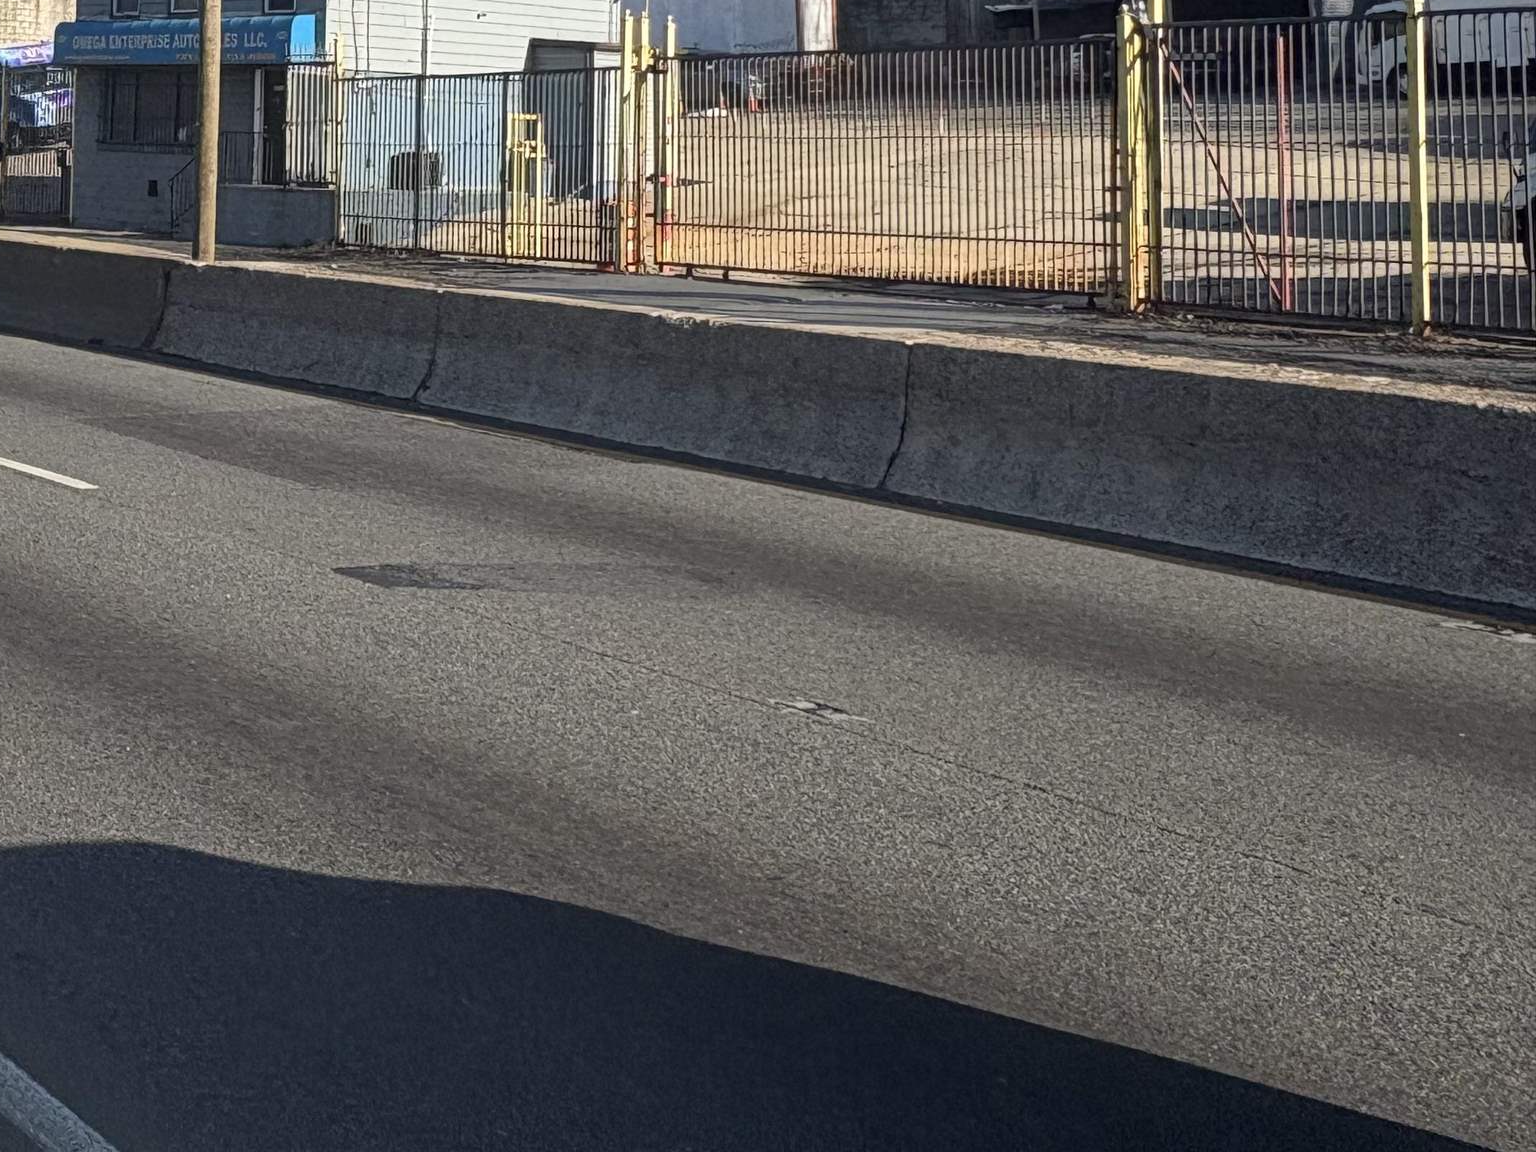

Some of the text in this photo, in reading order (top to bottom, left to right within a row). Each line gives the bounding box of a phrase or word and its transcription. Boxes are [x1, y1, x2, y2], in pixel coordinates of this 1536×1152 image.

[72, 35, 106, 49] OMEGA
[108, 33, 170, 49] ENTERPRISE
[172, 32, 201, 49] AUTO
